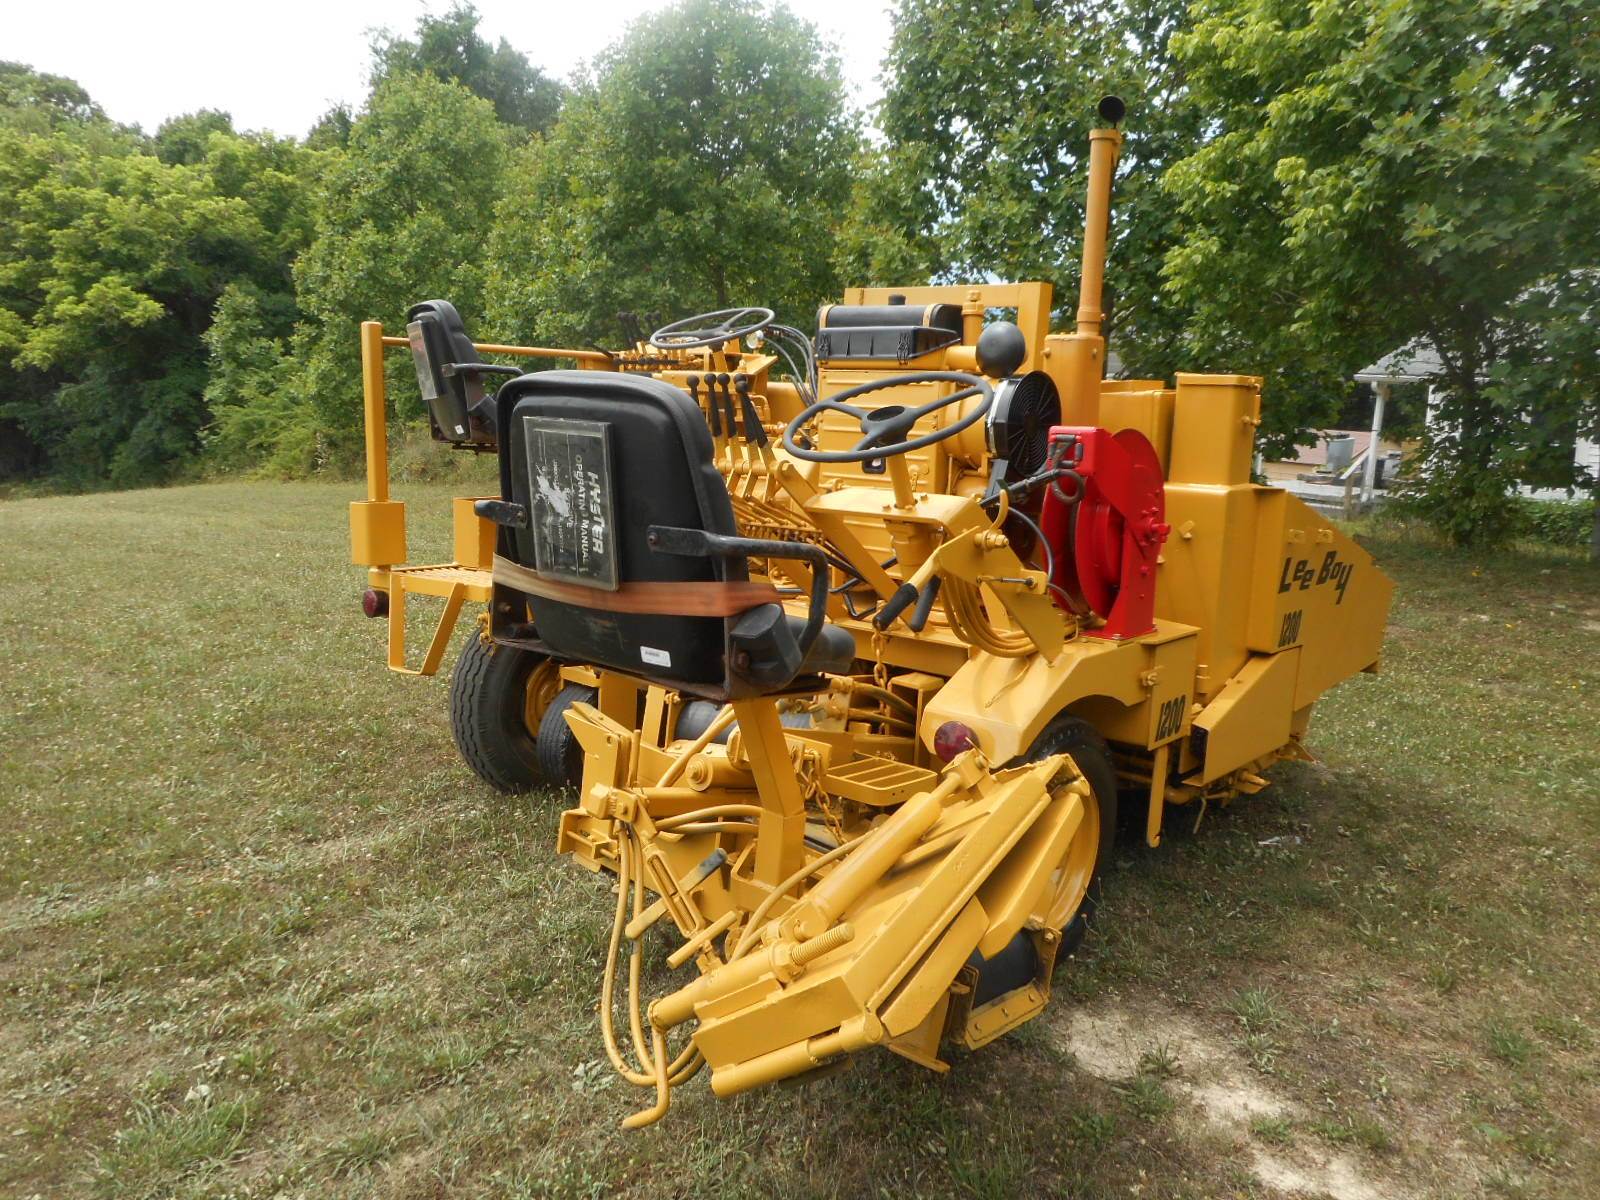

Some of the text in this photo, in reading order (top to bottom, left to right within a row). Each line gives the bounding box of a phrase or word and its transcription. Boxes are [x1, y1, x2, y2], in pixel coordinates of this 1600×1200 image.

[587, 471, 605, 554] HYSTER
[1278, 550, 1354, 605] Lee Boy
[1278, 609, 1302, 648] 1200
[1155, 694, 1186, 742] 1200
